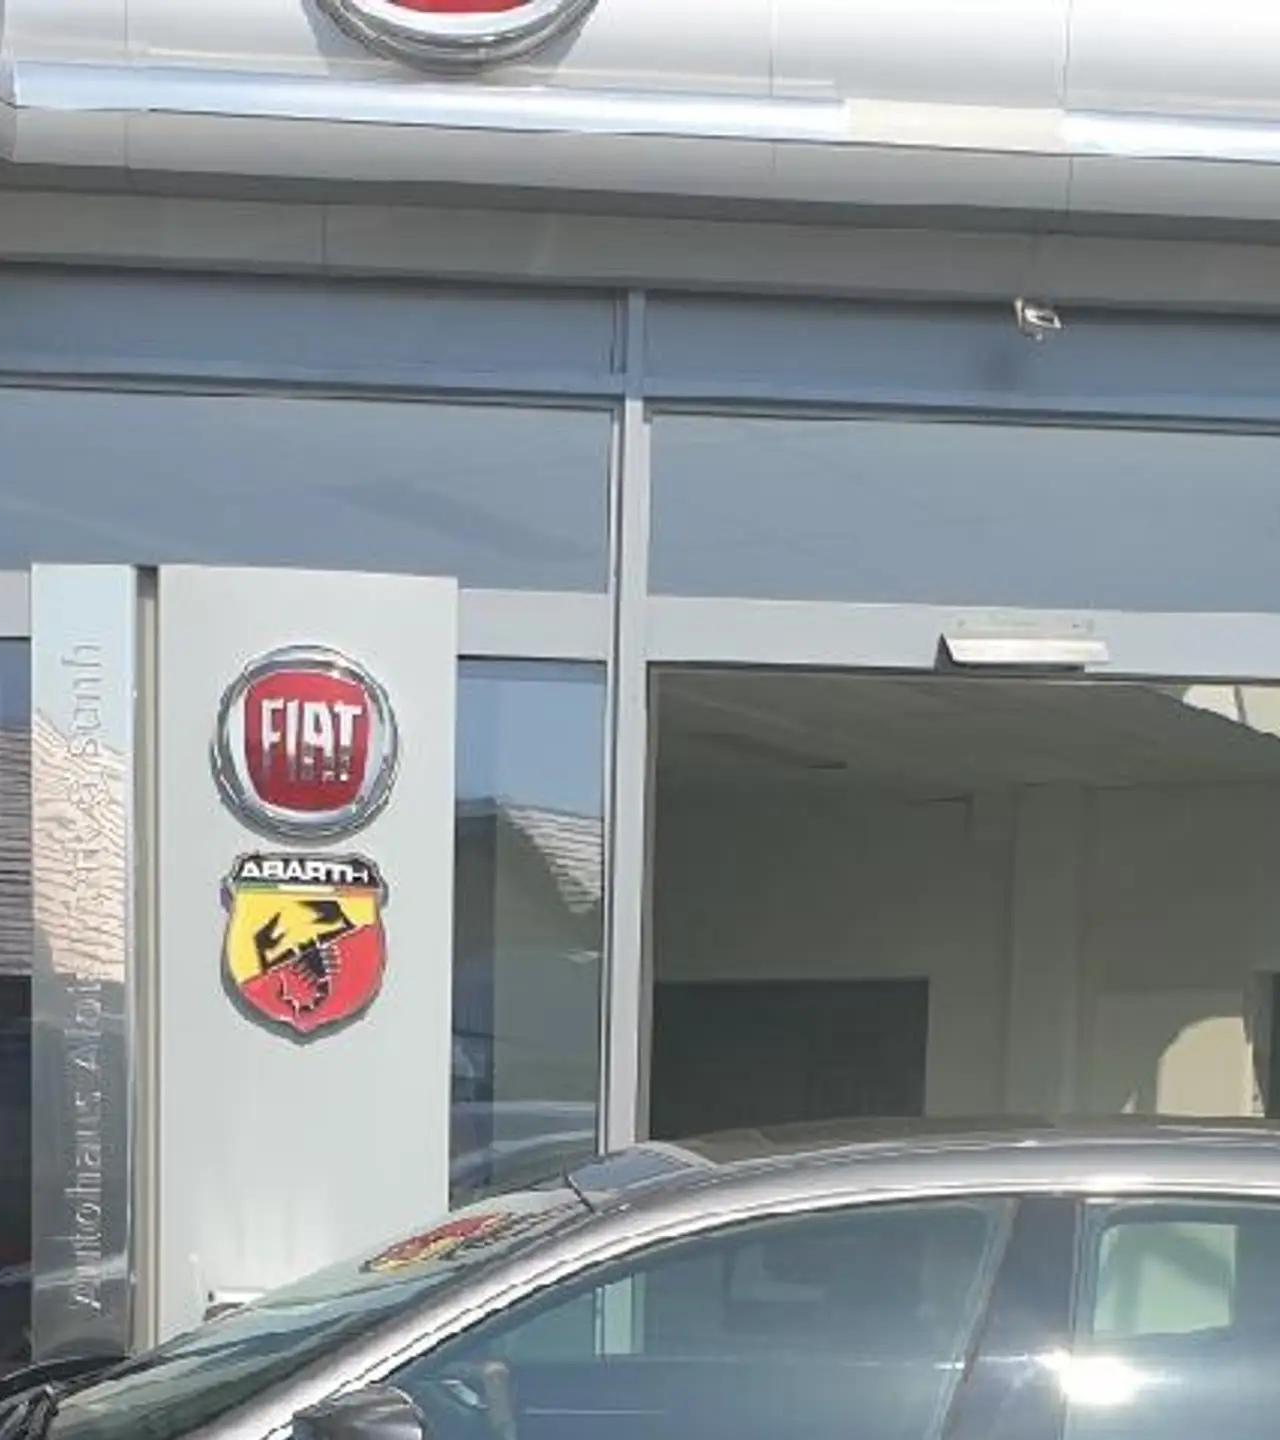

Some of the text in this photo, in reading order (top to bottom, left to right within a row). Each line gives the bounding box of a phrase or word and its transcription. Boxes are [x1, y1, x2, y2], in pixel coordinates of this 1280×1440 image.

[261, 697, 363, 781] FIAT
[241, 859, 370, 885] ABARTH
[64, 1090, 102, 1310] Autohaus
